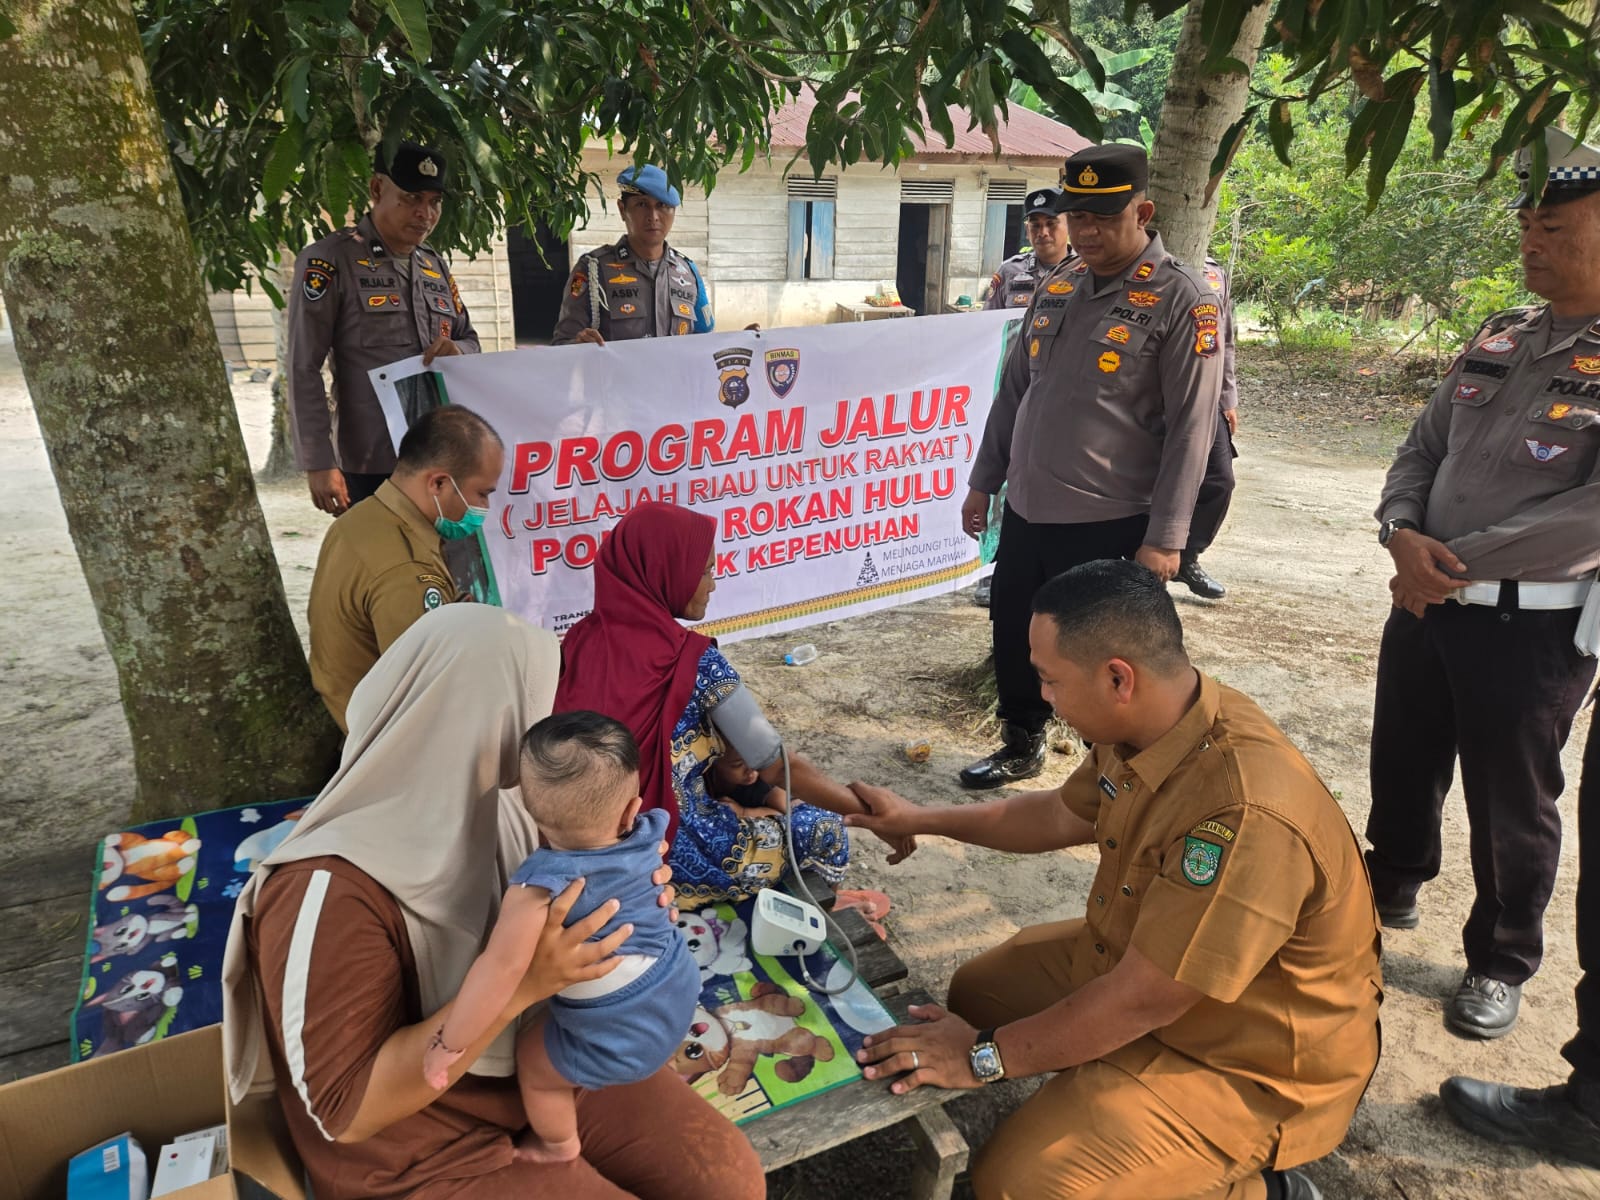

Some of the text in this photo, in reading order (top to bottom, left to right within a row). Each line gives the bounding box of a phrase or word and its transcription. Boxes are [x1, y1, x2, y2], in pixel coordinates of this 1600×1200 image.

[611, 288, 639, 298] ASBY
[1109, 306, 1153, 327] POLRI
[769, 350, 795, 360] BINMAS
[508, 385, 972, 495] PROGRAM JALUR
[523, 482, 678, 530] JELAJAH
[687, 469, 758, 505] RIAU
[765, 451, 859, 491] UNTUK
[865, 434, 959, 474] RAKYAT
[721, 467, 956, 543] ROKAN HULU
[746, 512, 920, 573] KEPENUHAN
[883, 535, 967, 562] MELINDUNGI TUAH
[881, 550, 967, 577] MENJAGA MARWAH
